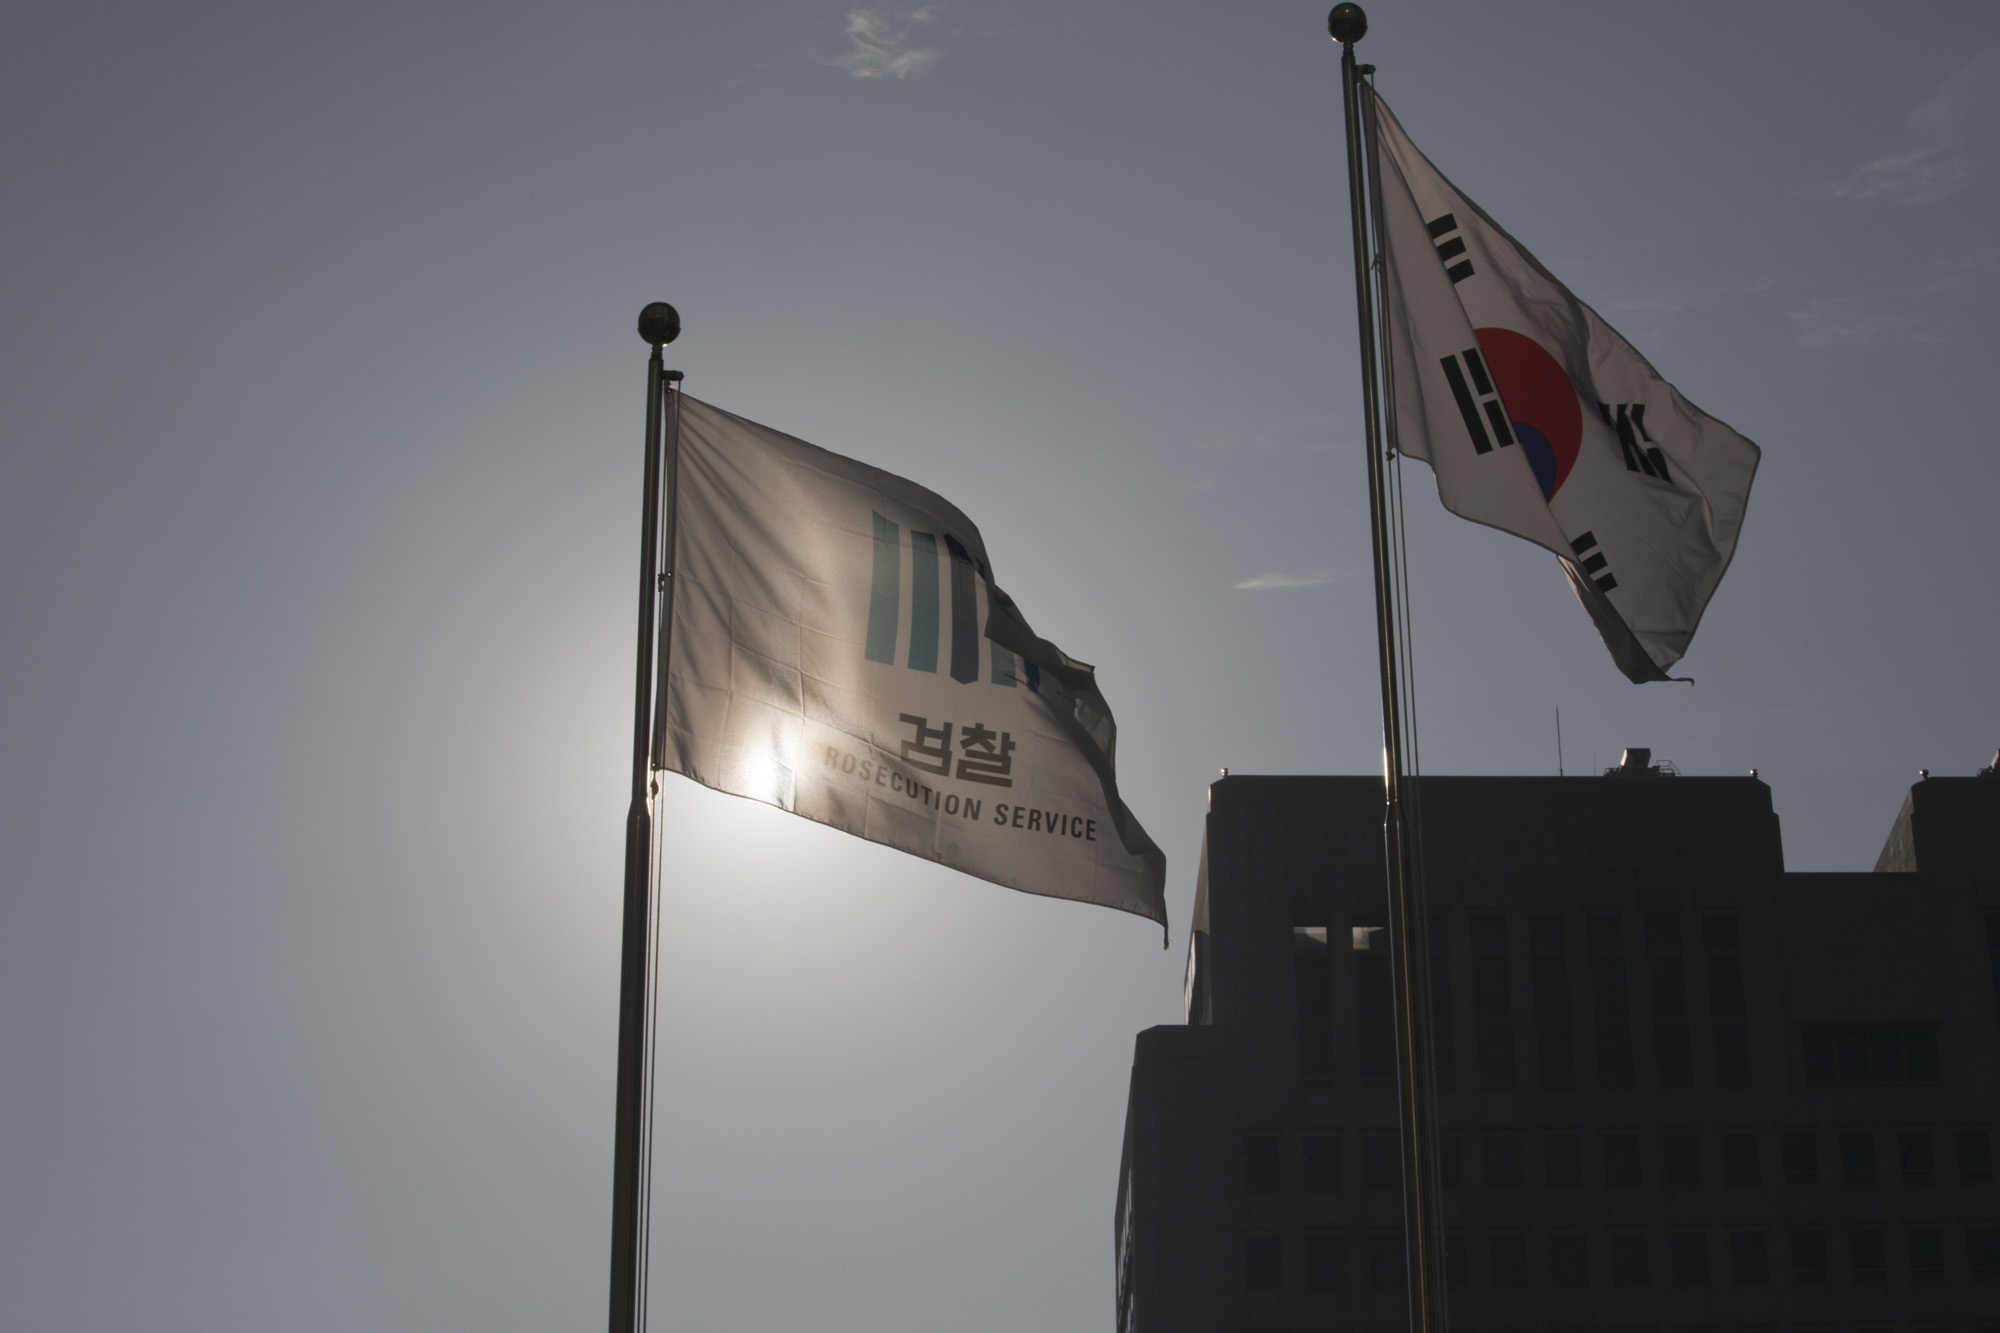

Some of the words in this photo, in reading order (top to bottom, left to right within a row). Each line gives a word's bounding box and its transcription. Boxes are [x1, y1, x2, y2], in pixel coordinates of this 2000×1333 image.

[825, 745, 982, 821] ROSECUTION
[993, 802, 1097, 841] SERVICE
[899, 713, 1016, 788] 검찰
